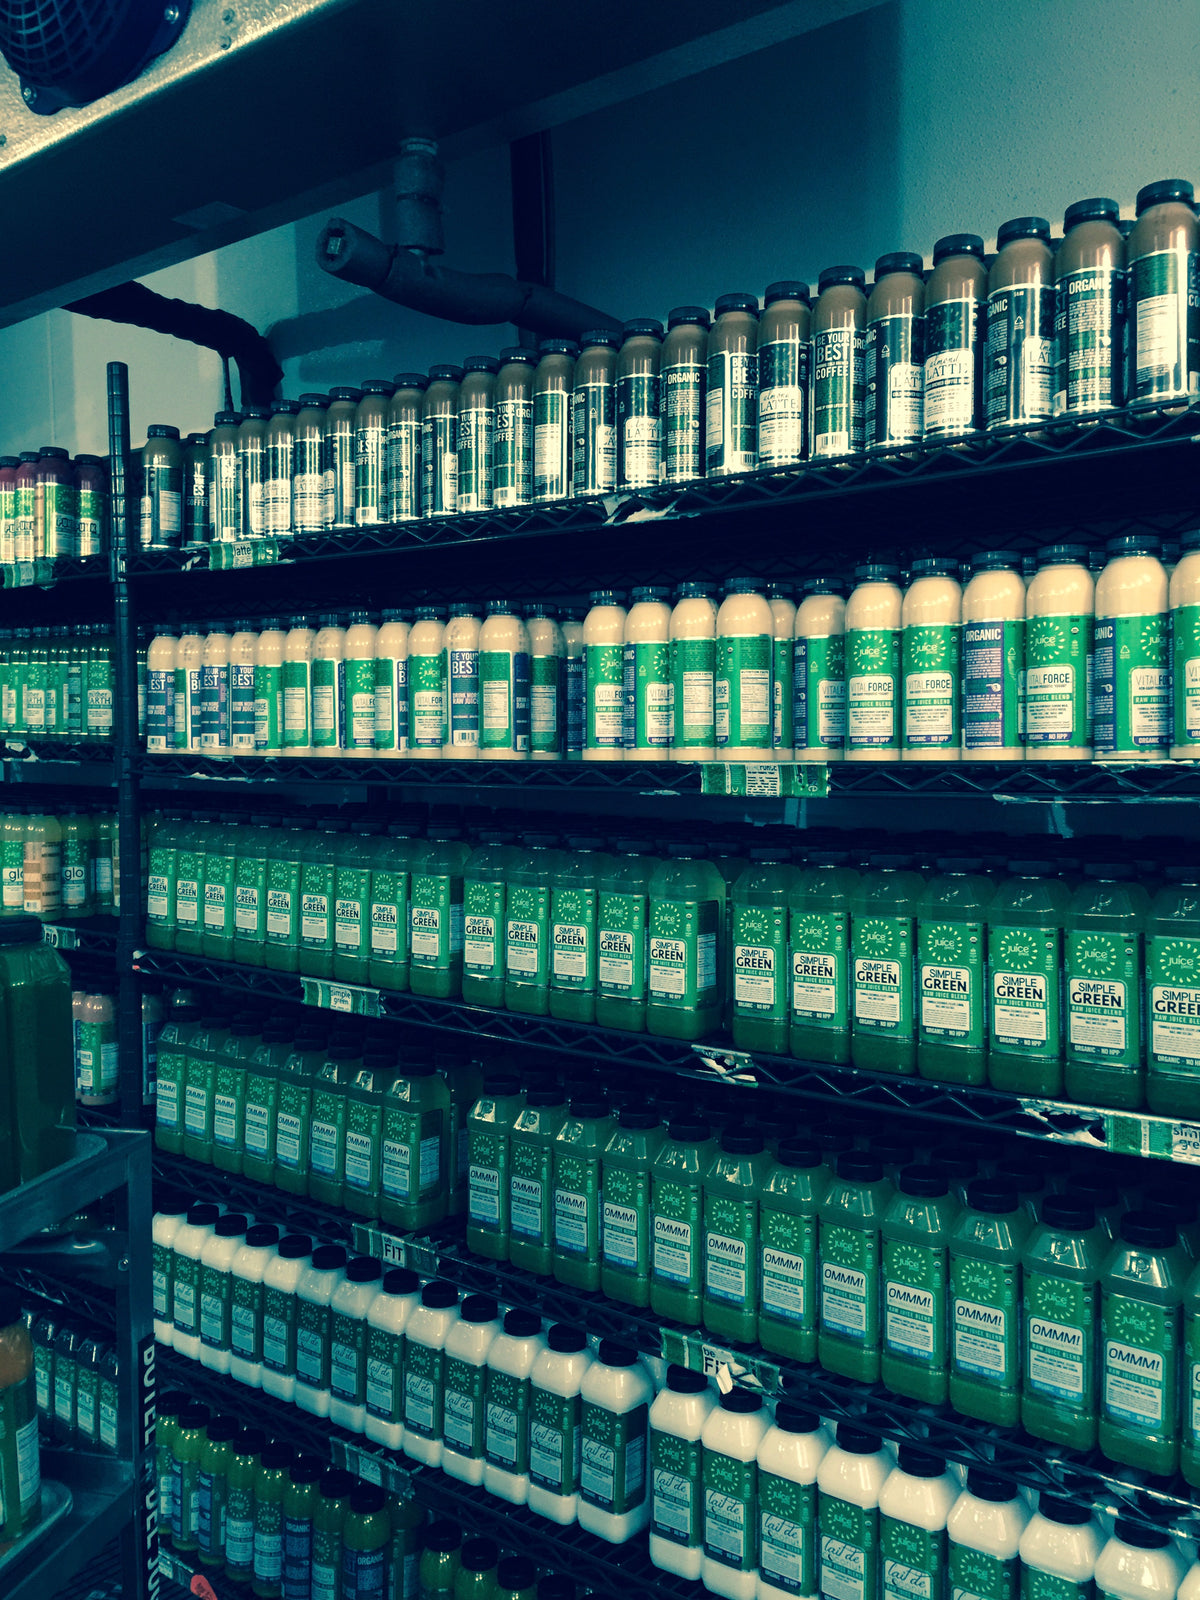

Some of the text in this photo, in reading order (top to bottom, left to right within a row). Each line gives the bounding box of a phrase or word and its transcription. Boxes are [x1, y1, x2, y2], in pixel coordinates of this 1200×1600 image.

[827, 332, 849, 345] YOUR
[816, 344, 848, 363] BEST
[816, 366, 848, 380] COFFEE
[966, 628, 1001, 642] ORGANIC
[1034, 635, 1056, 647] juice
[859, 646, 880, 657] juice
[916, 643, 937, 654] juice
[65, 867, 83, 880] glo
[303, 903, 325, 912] GREEN
[336, 908, 359, 918] GREEN
[372, 913, 395, 922] GREEN
[416, 910, 434, 918] SIMPLE
[412, 918, 437, 927] GREEN
[469, 918, 489, 926] SIMPLE
[512, 923, 532, 933] SIMPLE
[466, 926, 492, 935] GREEN
[509, 930, 536, 942] GREEN
[559, 927, 580, 936] SIMPLE
[555, 935, 584, 945] GREEN
[604, 933, 627, 942] SIMPLE
[934, 938, 955, 948] juice
[601, 941, 630, 953] GREEN
[656, 941, 679, 950] SIMPLE
[1008, 943, 1029, 954] juice
[651, 949, 683, 961] GREEN
[741, 949, 767, 959] SIMPLE
[1084, 949, 1107, 960] juice
[736, 957, 772, 969] GREEN
[800, 956, 828, 966] SIMPLE
[862, 962, 892, 972] SIMPLE
[1167, 955, 1194, 968] juice
[795, 965, 833, 977] GREEN
[929, 969, 961, 980] SIMPLE
[857, 971, 897, 984] GREEN
[1002, 976, 1036, 987] SIMPLE
[924, 978, 966, 992] GREEN
[1078, 982, 1115, 995] SIMPLE
[996, 986, 1043, 1000] GREEN
[1072, 993, 1121, 1007] GREEN
[556, 1194, 585, 1209] OMMM!
[604, 1208, 635, 1223] OMMM!
[656, 1221, 689, 1238] OMMM!
[384, 1244, 403, 1260] FIT
[708, 1238, 744, 1256] OMMM!
[765, 1253, 801, 1271] OMMM!
[824, 1269, 864, 1287] OMMM!
[888, 1287, 931, 1306] OMMM!
[956, 1306, 1002, 1326] OMMM!
[1032, 1324, 1080, 1346] OMMM!
[1108, 1348, 1160, 1372] OMMM!
